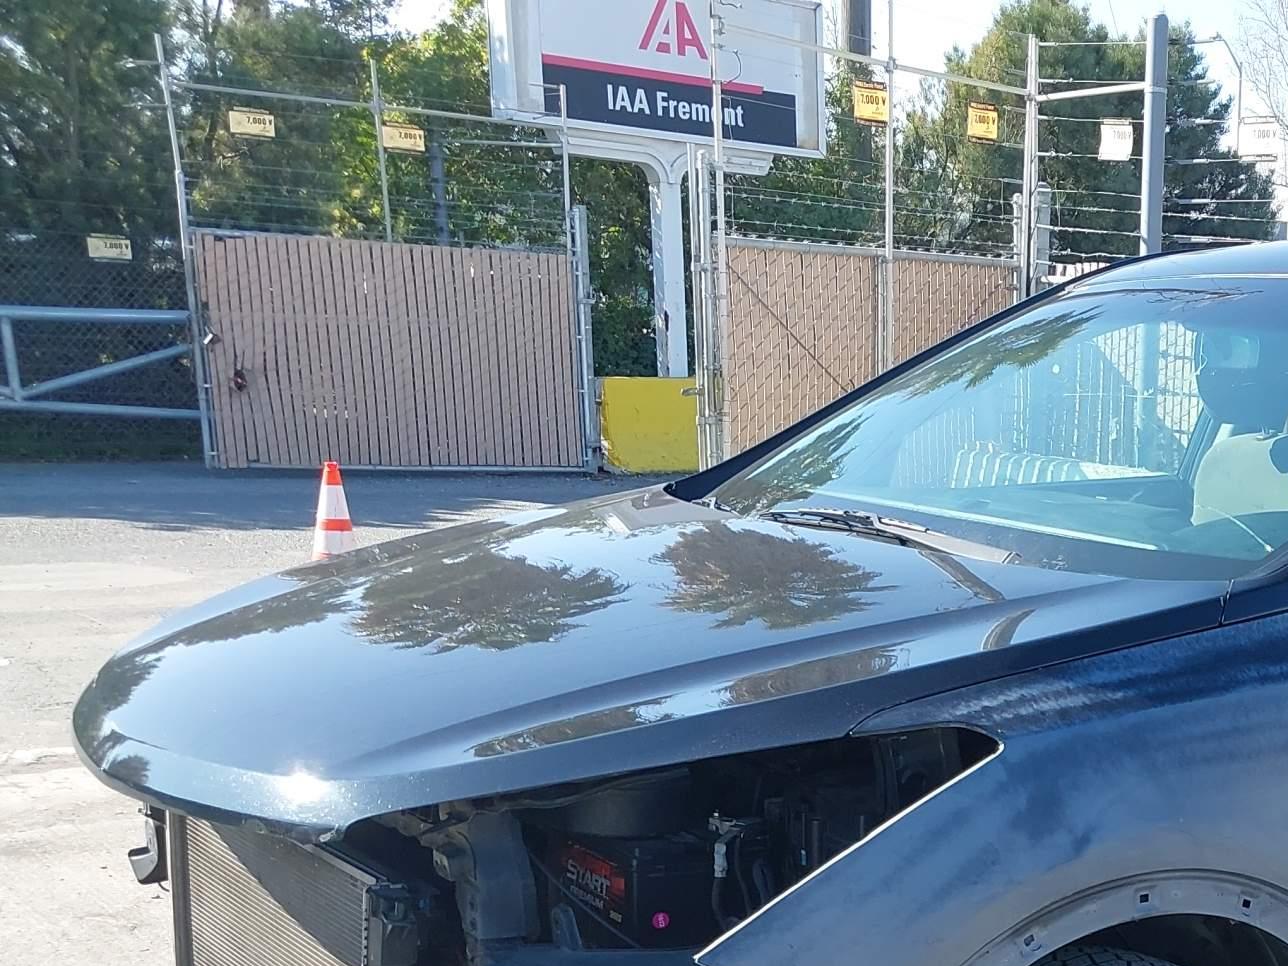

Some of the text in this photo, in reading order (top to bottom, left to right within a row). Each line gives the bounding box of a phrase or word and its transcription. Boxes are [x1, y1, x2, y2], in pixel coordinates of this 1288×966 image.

[607, 83, 744, 128] IAA Fremnt
[566, 858, 611, 897] START
